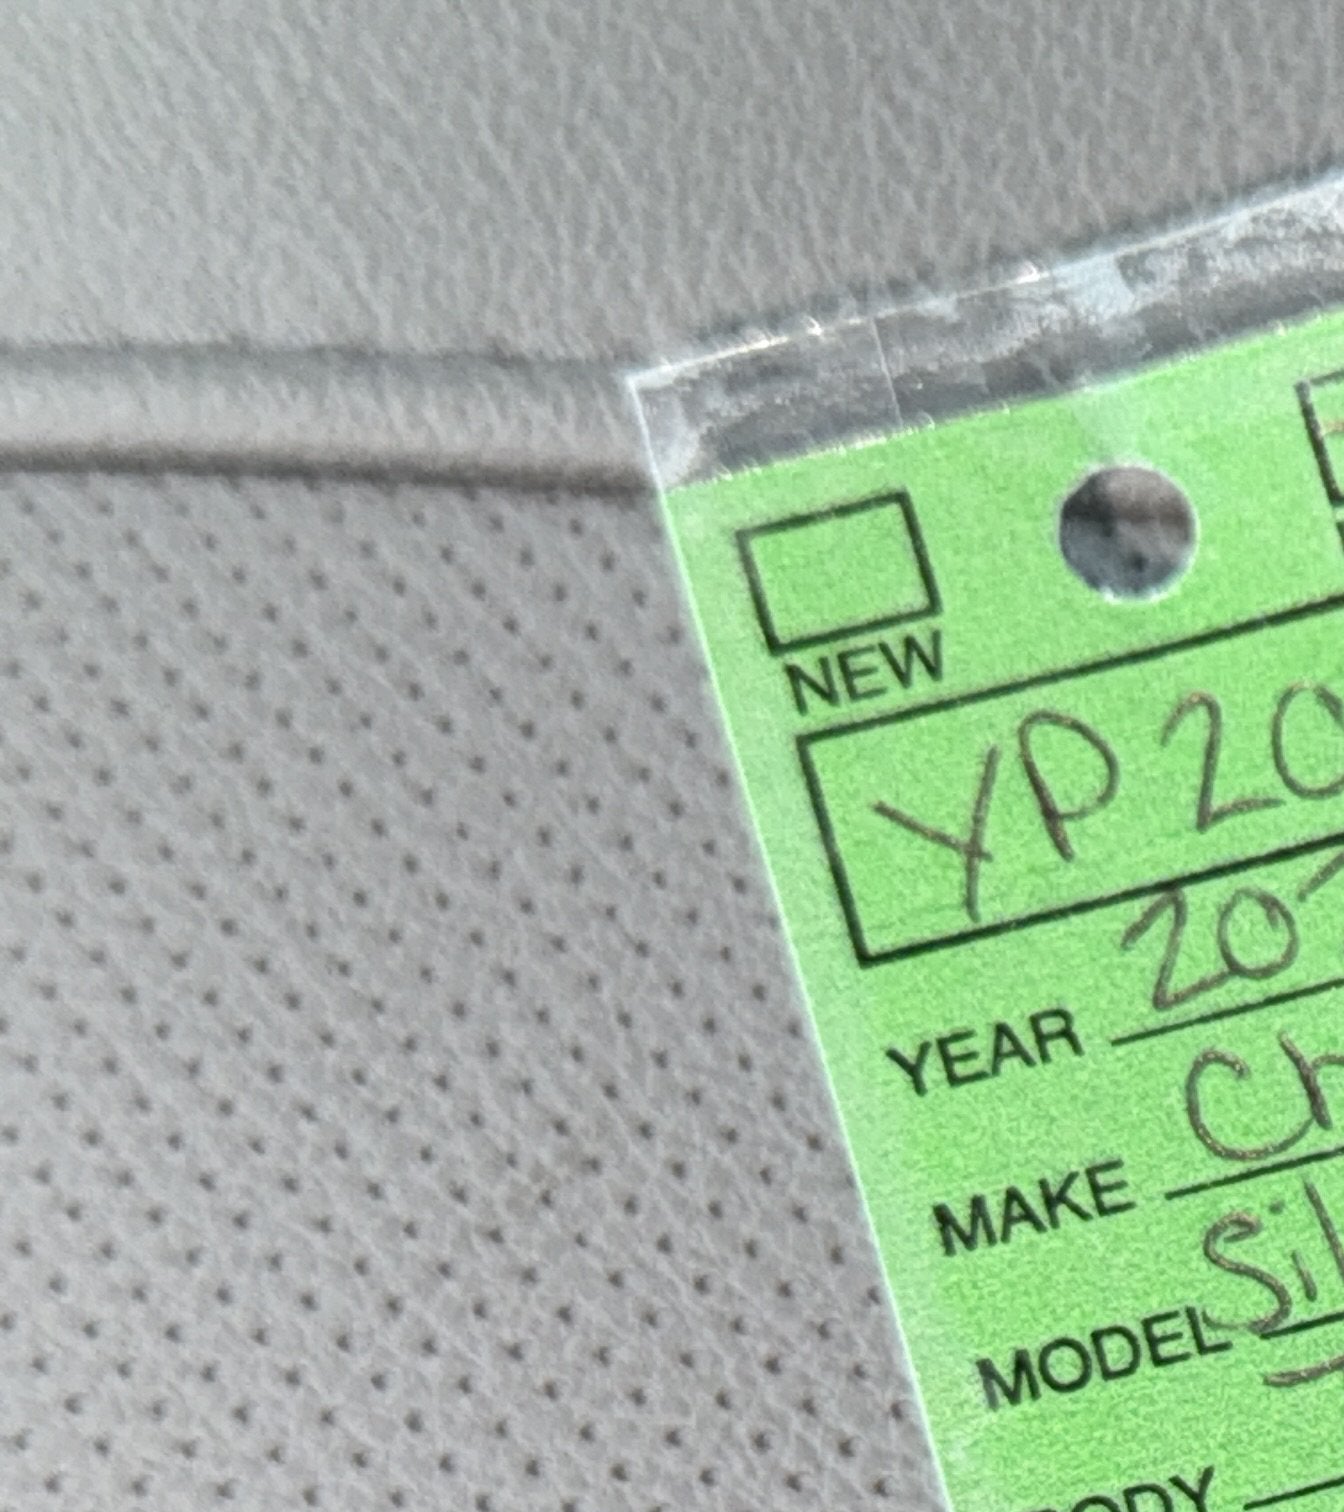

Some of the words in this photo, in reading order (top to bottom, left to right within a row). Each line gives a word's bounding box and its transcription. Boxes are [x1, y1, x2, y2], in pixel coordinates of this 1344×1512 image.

[785, 630, 945, 714] NEW
[886, 1006, 1084, 1097] YEAR
[932, 1159, 1137, 1257] MAKE
[976, 1305, 1231, 1412] MODEL
